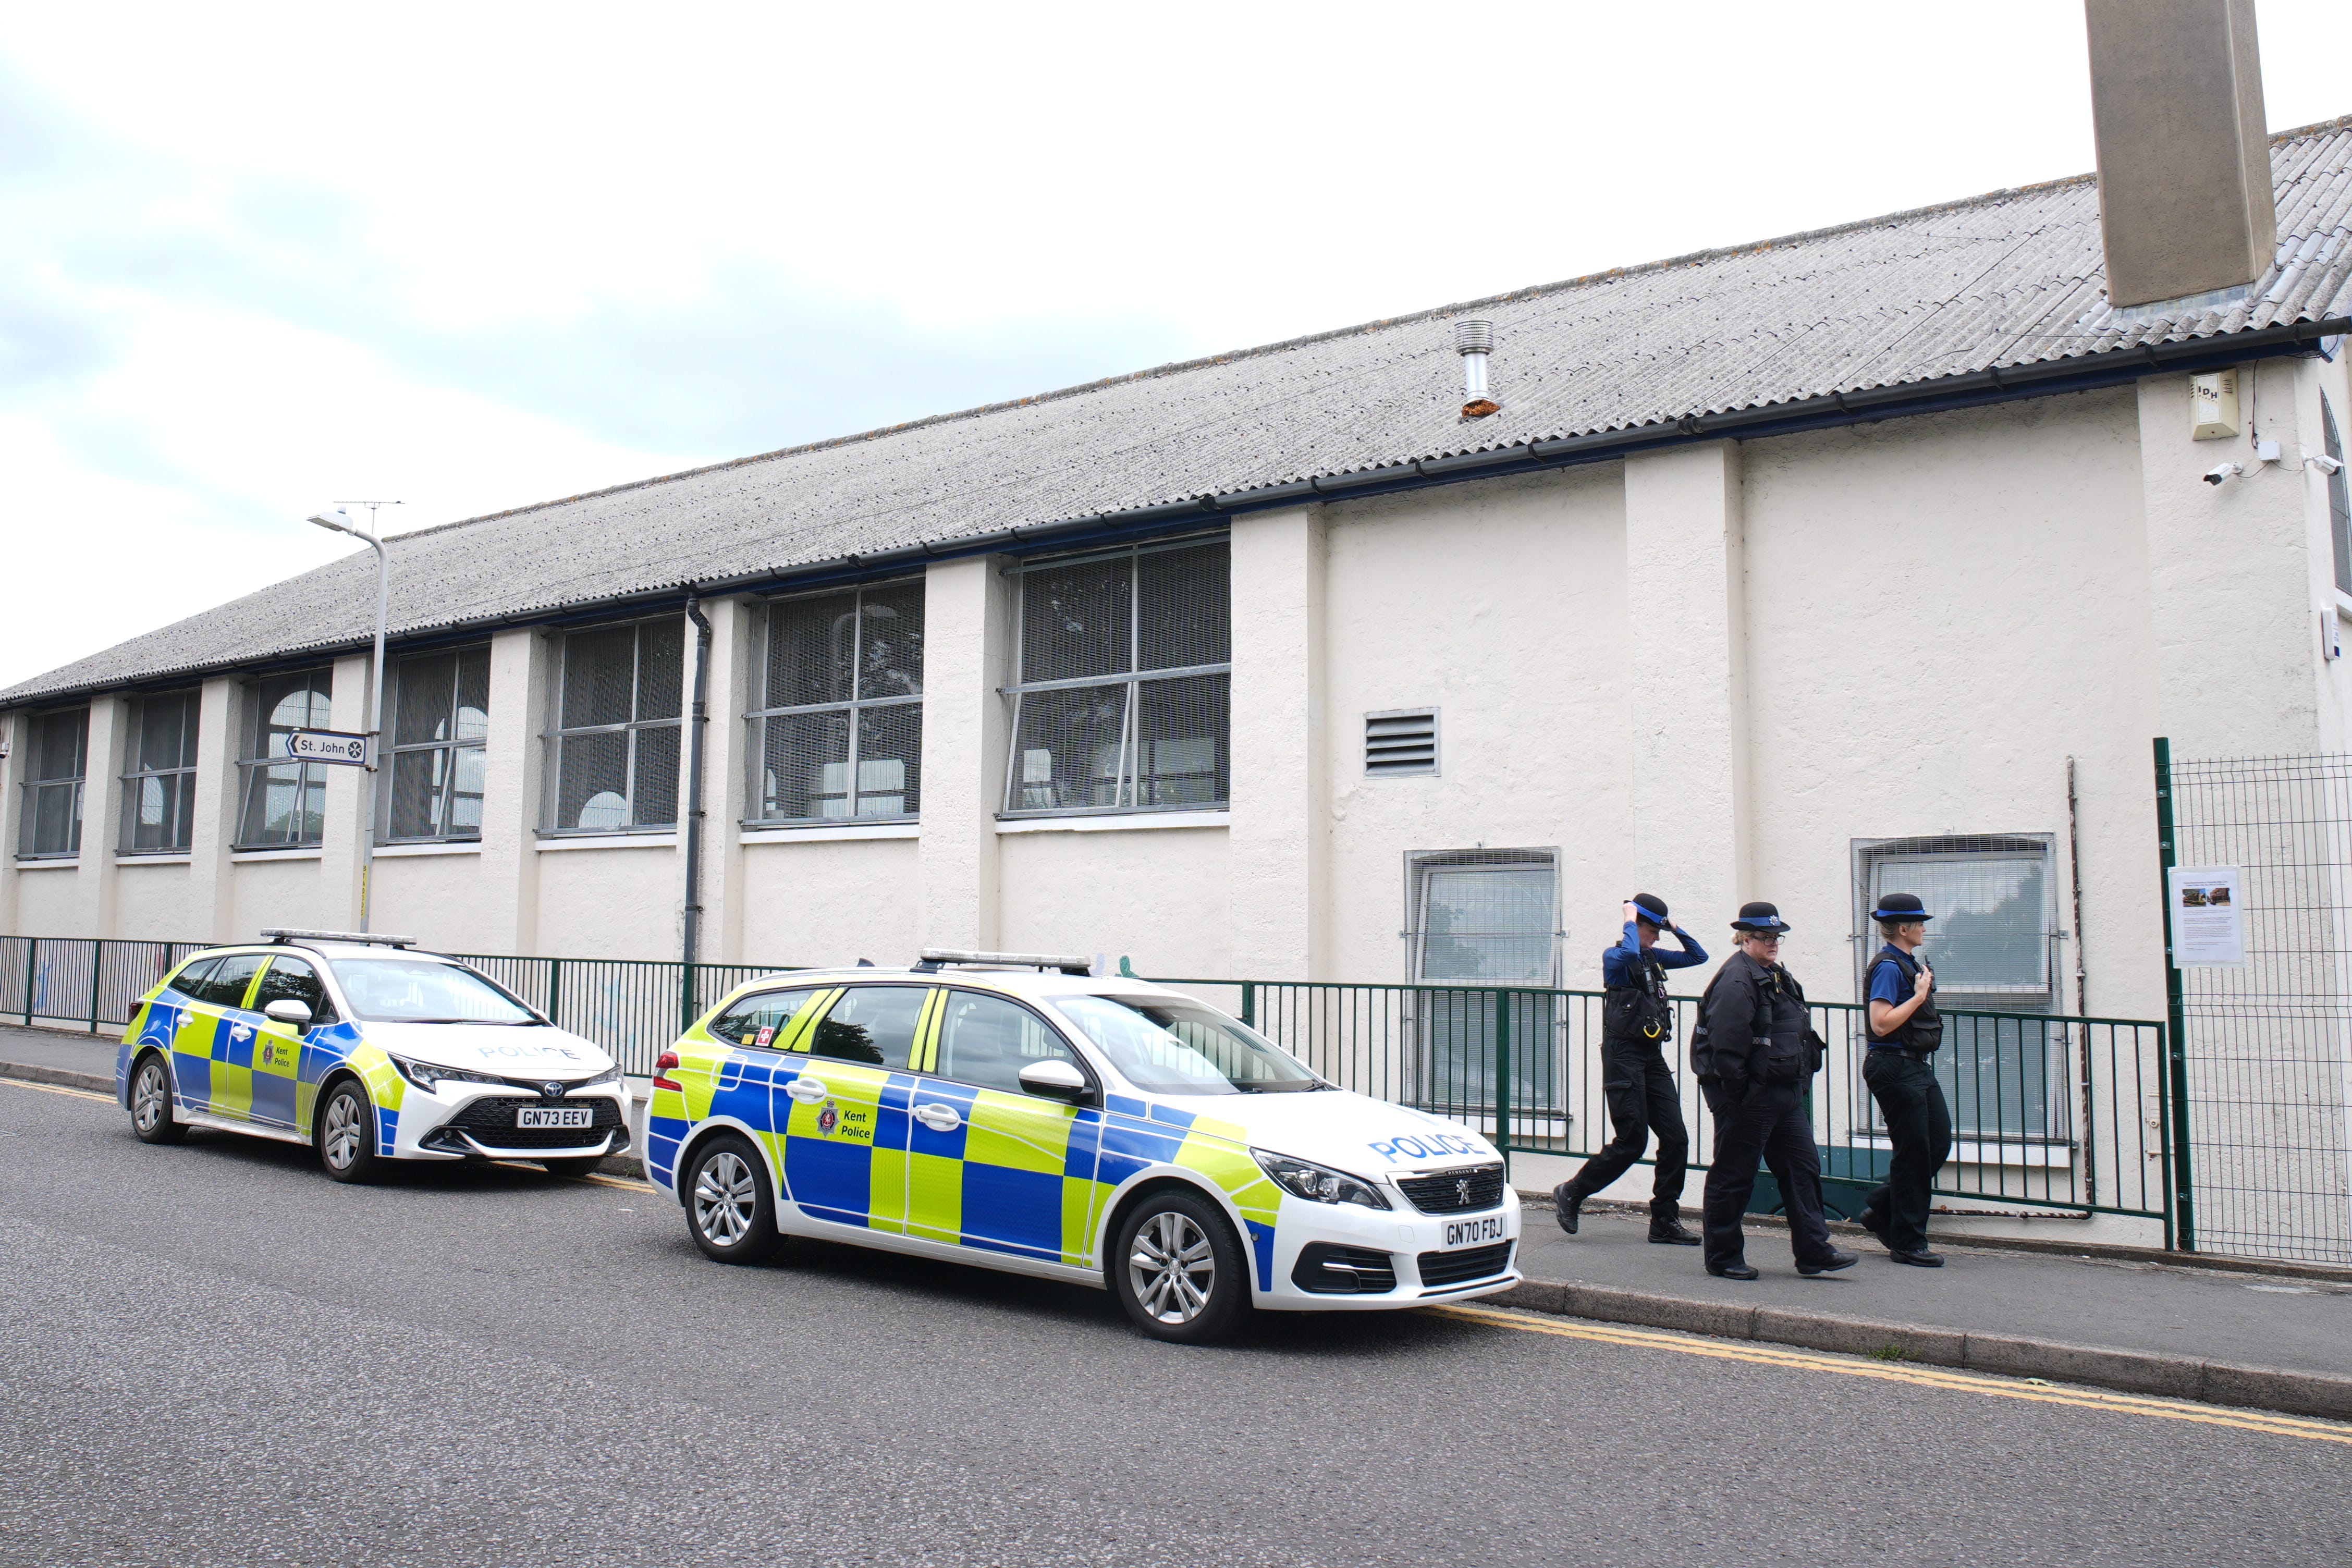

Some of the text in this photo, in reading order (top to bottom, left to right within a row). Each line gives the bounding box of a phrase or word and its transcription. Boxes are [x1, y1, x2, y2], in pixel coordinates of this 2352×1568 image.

[2198, 386, 2218, 399] IDH
[301, 740, 345, 754] St. John
[276, 1046, 288, 1056] Kent
[478, 1047, 581, 1060] POLICE
[275, 1058, 290, 1067] Police
[523, 1111, 589, 1125] GN73 EEV
[844, 1110, 866, 1122] Kent
[841, 1125, 871, 1138] Police
[1367, 1134, 1487, 1163] POLICE
[1447, 1217, 1503, 1245] GN70 FDJ
